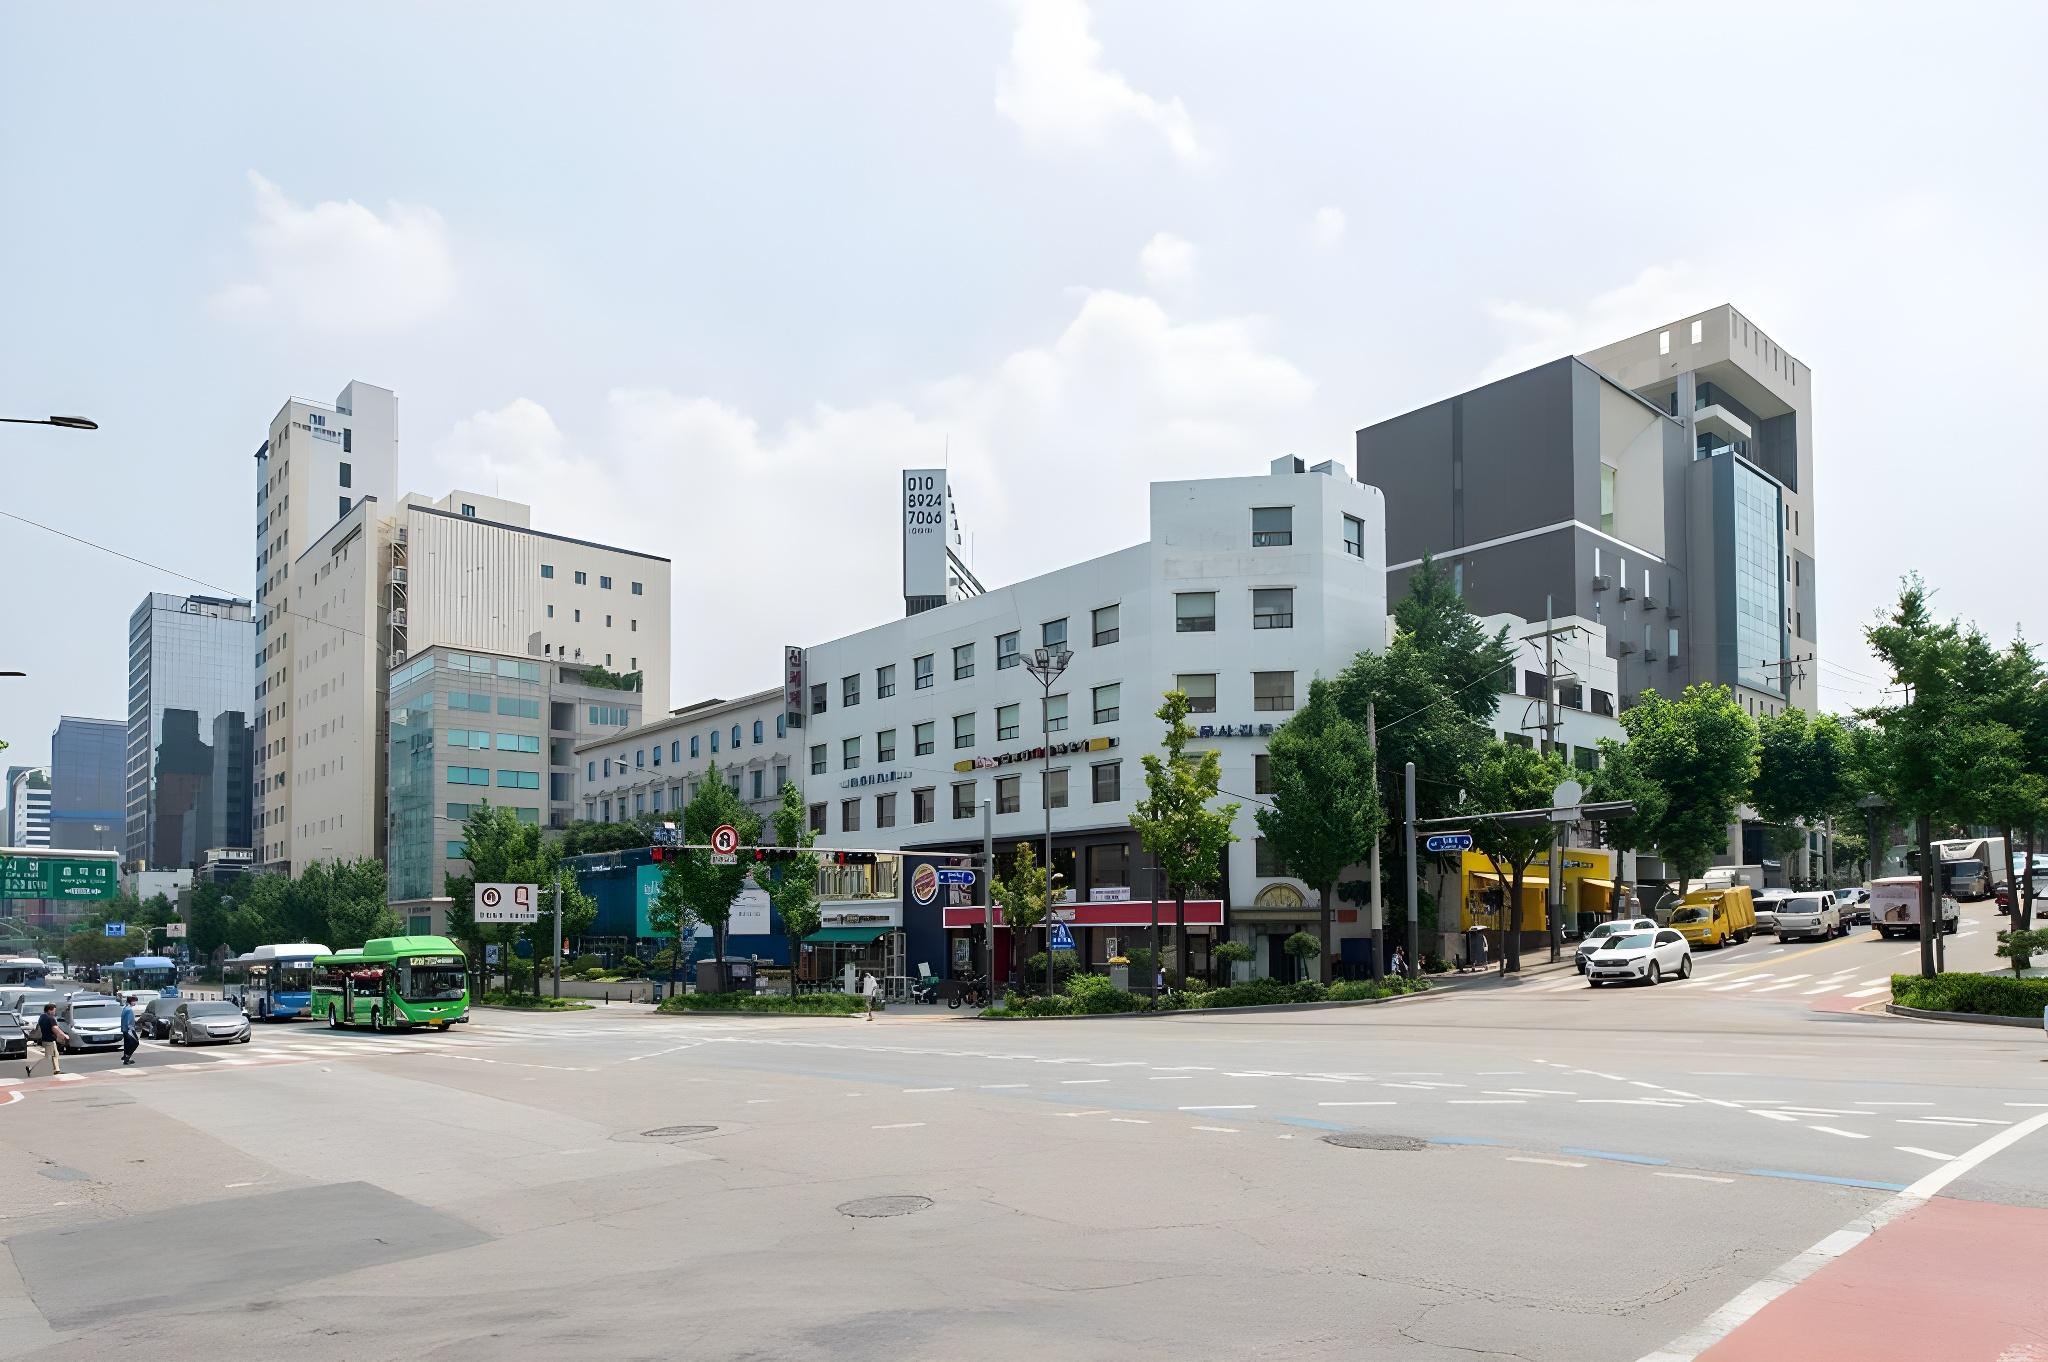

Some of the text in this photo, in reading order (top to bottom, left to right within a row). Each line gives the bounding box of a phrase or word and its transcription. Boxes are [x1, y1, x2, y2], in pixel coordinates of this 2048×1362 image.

[908, 476, 934, 491] 010
[908, 493, 942, 508] 8924
[908, 510, 942, 525] 7066
